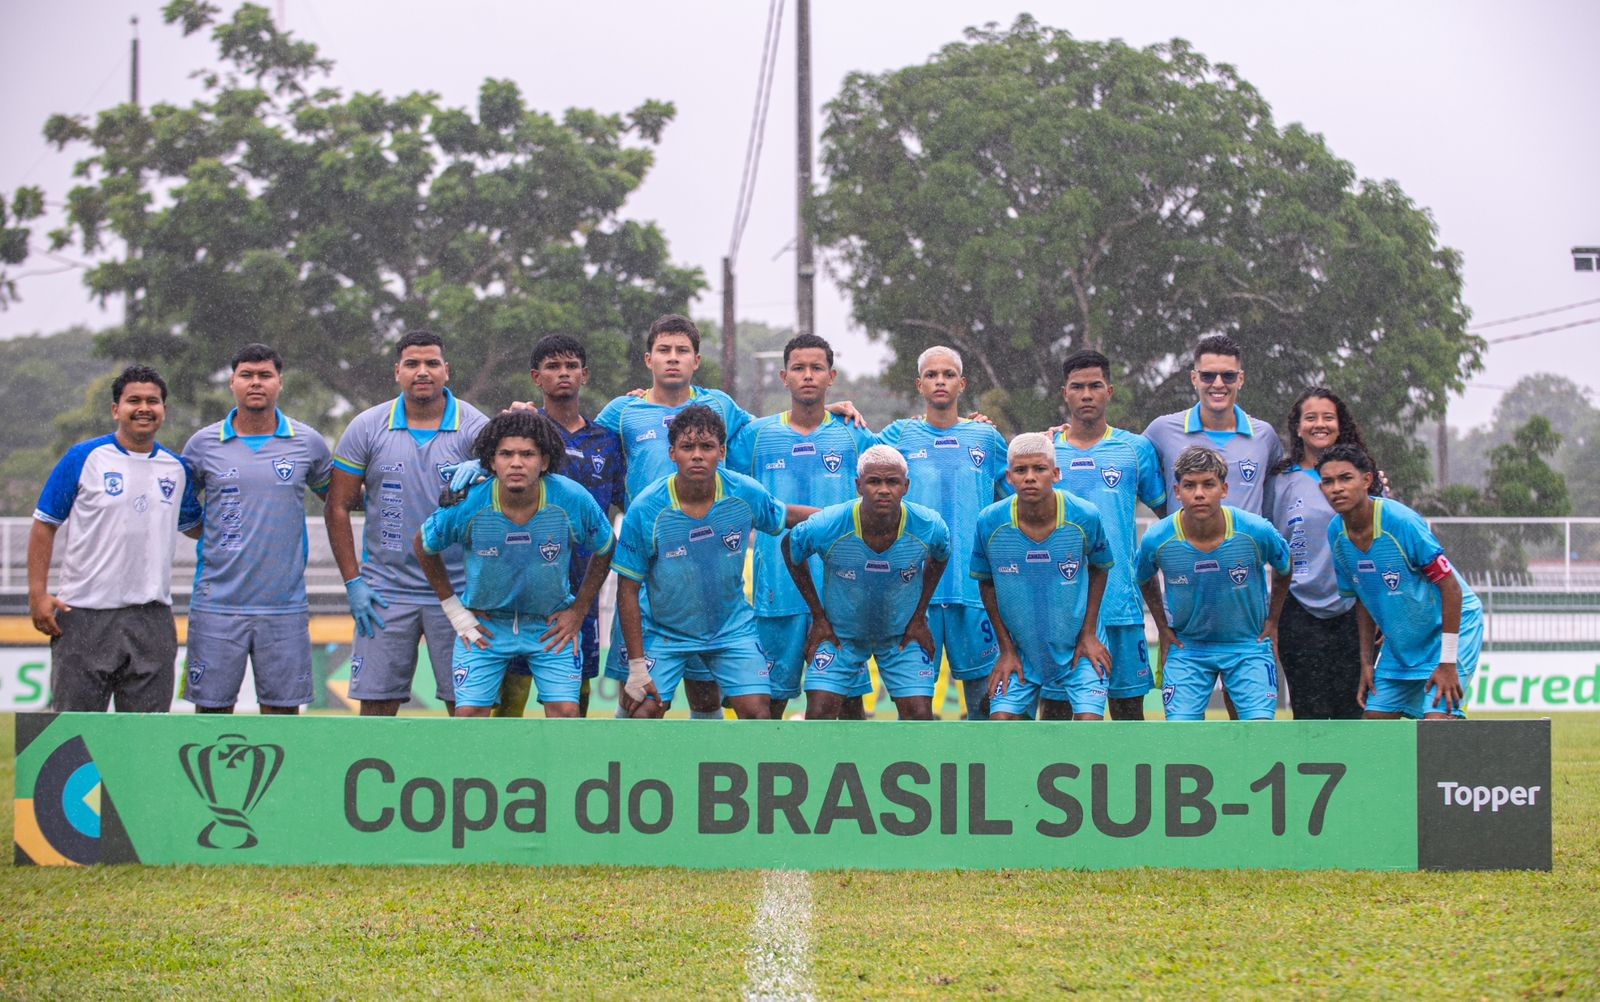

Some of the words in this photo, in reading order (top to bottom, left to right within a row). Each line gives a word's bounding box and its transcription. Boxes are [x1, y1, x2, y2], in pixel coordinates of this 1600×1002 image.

[980, 619, 994, 643] 9
[1467, 663, 1600, 705] icred
[344, 757, 547, 849] Copa
[574, 760, 674, 834] do
[697, 760, 1013, 836] BRASIL
[1035, 761, 1347, 838] SUB-17
[1437, 781, 1541, 812] Topper
